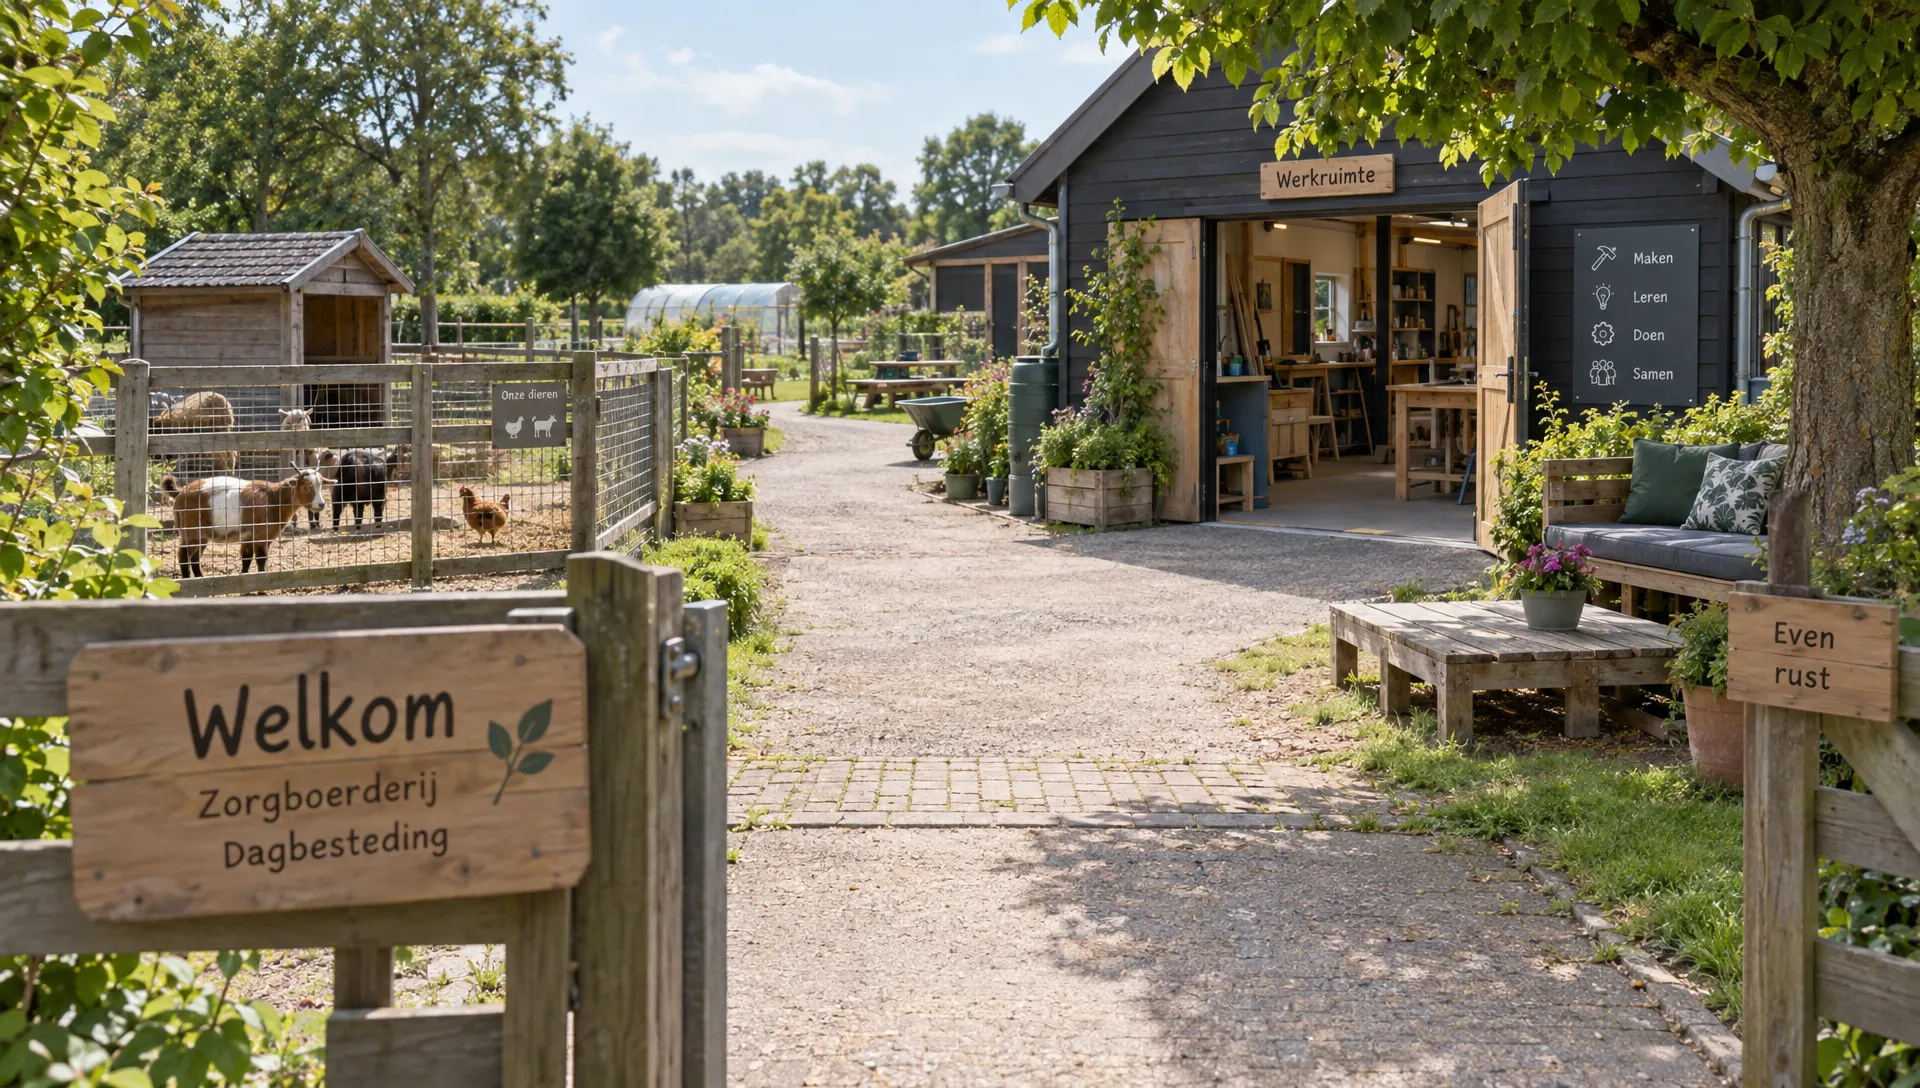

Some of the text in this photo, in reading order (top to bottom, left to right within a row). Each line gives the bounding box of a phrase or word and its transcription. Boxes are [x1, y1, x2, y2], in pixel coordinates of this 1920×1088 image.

[1276, 167, 1376, 188] Werkruimte
[1633, 251, 1674, 265] Maken
[1633, 291, 1668, 304] Leren
[1633, 328, 1665, 341] Doen
[1633, 366, 1674, 380] Samen
[501, 388, 558, 401] Onze dieren
[1775, 621, 1834, 650] Even
[1775, 666, 1831, 690] rust
[185, 671, 453, 759] Welkom
[199, 772, 437, 824] Zorgboerderij
[224, 822, 448, 873] Dagbesteding
